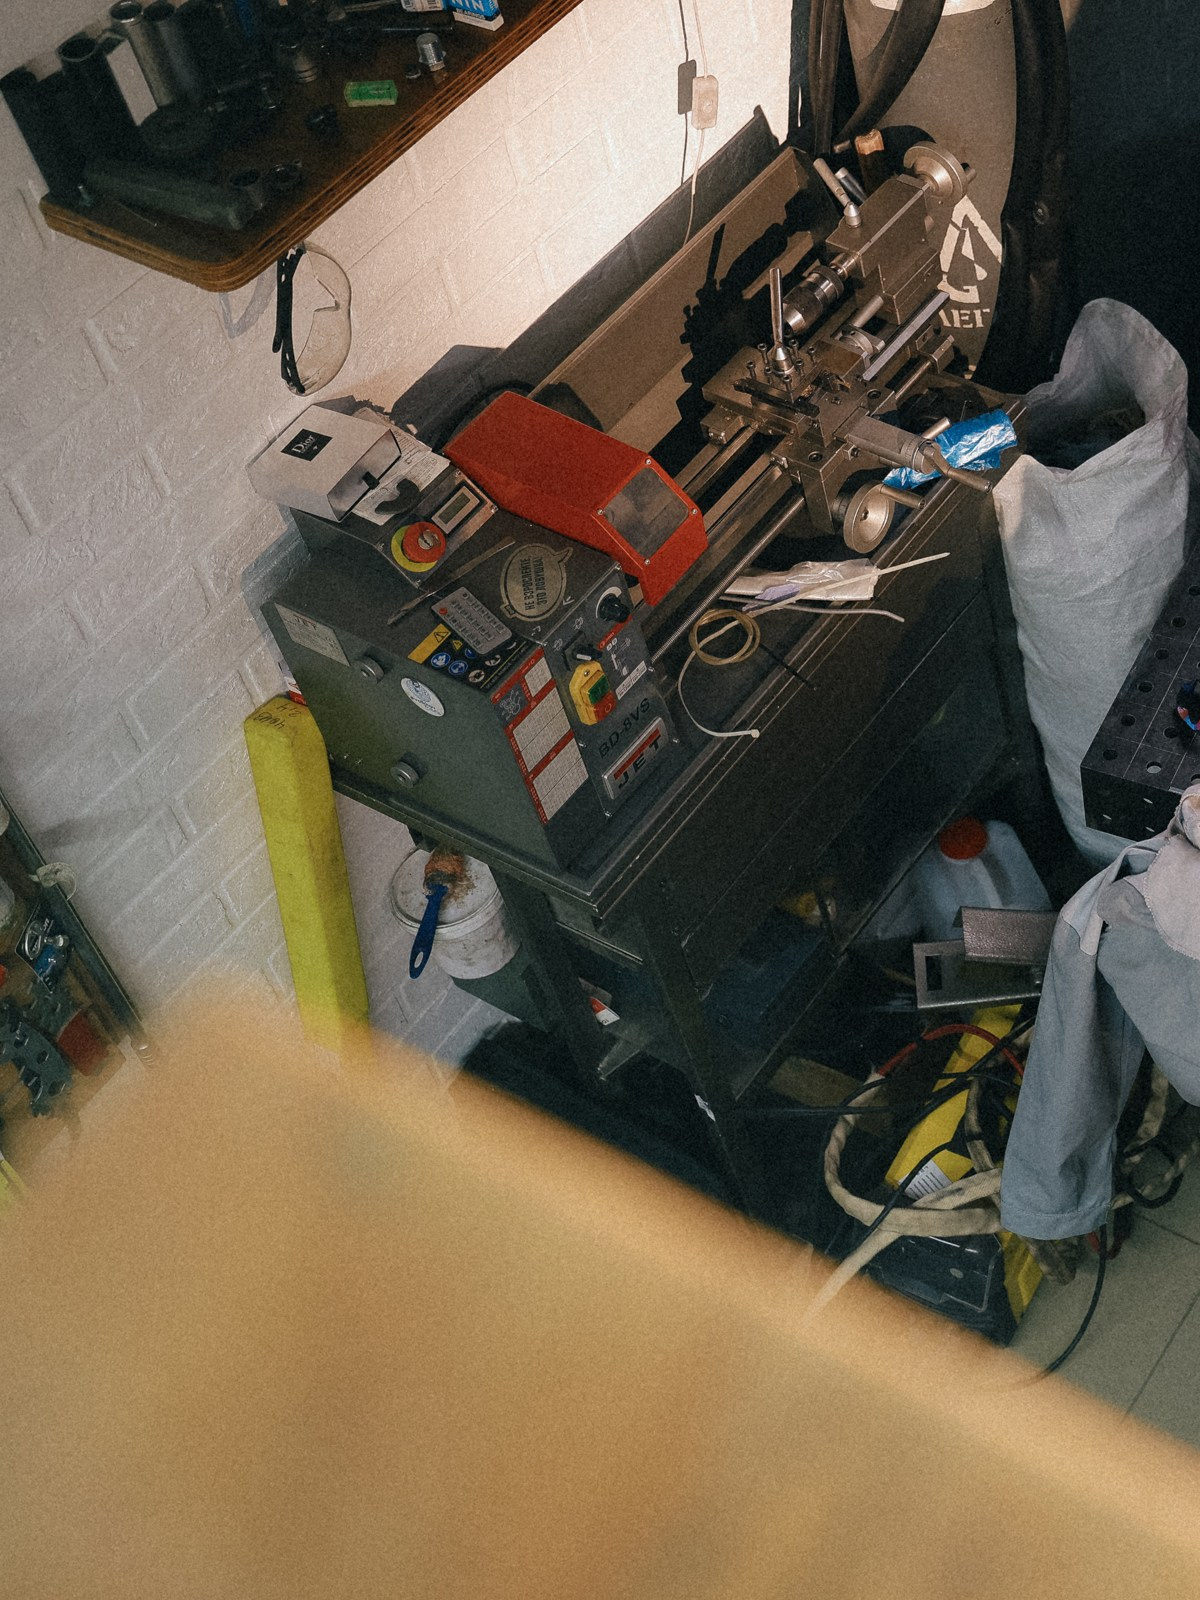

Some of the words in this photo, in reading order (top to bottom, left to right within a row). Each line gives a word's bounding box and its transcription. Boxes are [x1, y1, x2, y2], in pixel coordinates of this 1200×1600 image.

[291, 434, 315, 453] Dior
[598, 697, 650, 759] BD-8VS
[618, 734, 662, 789] JET
